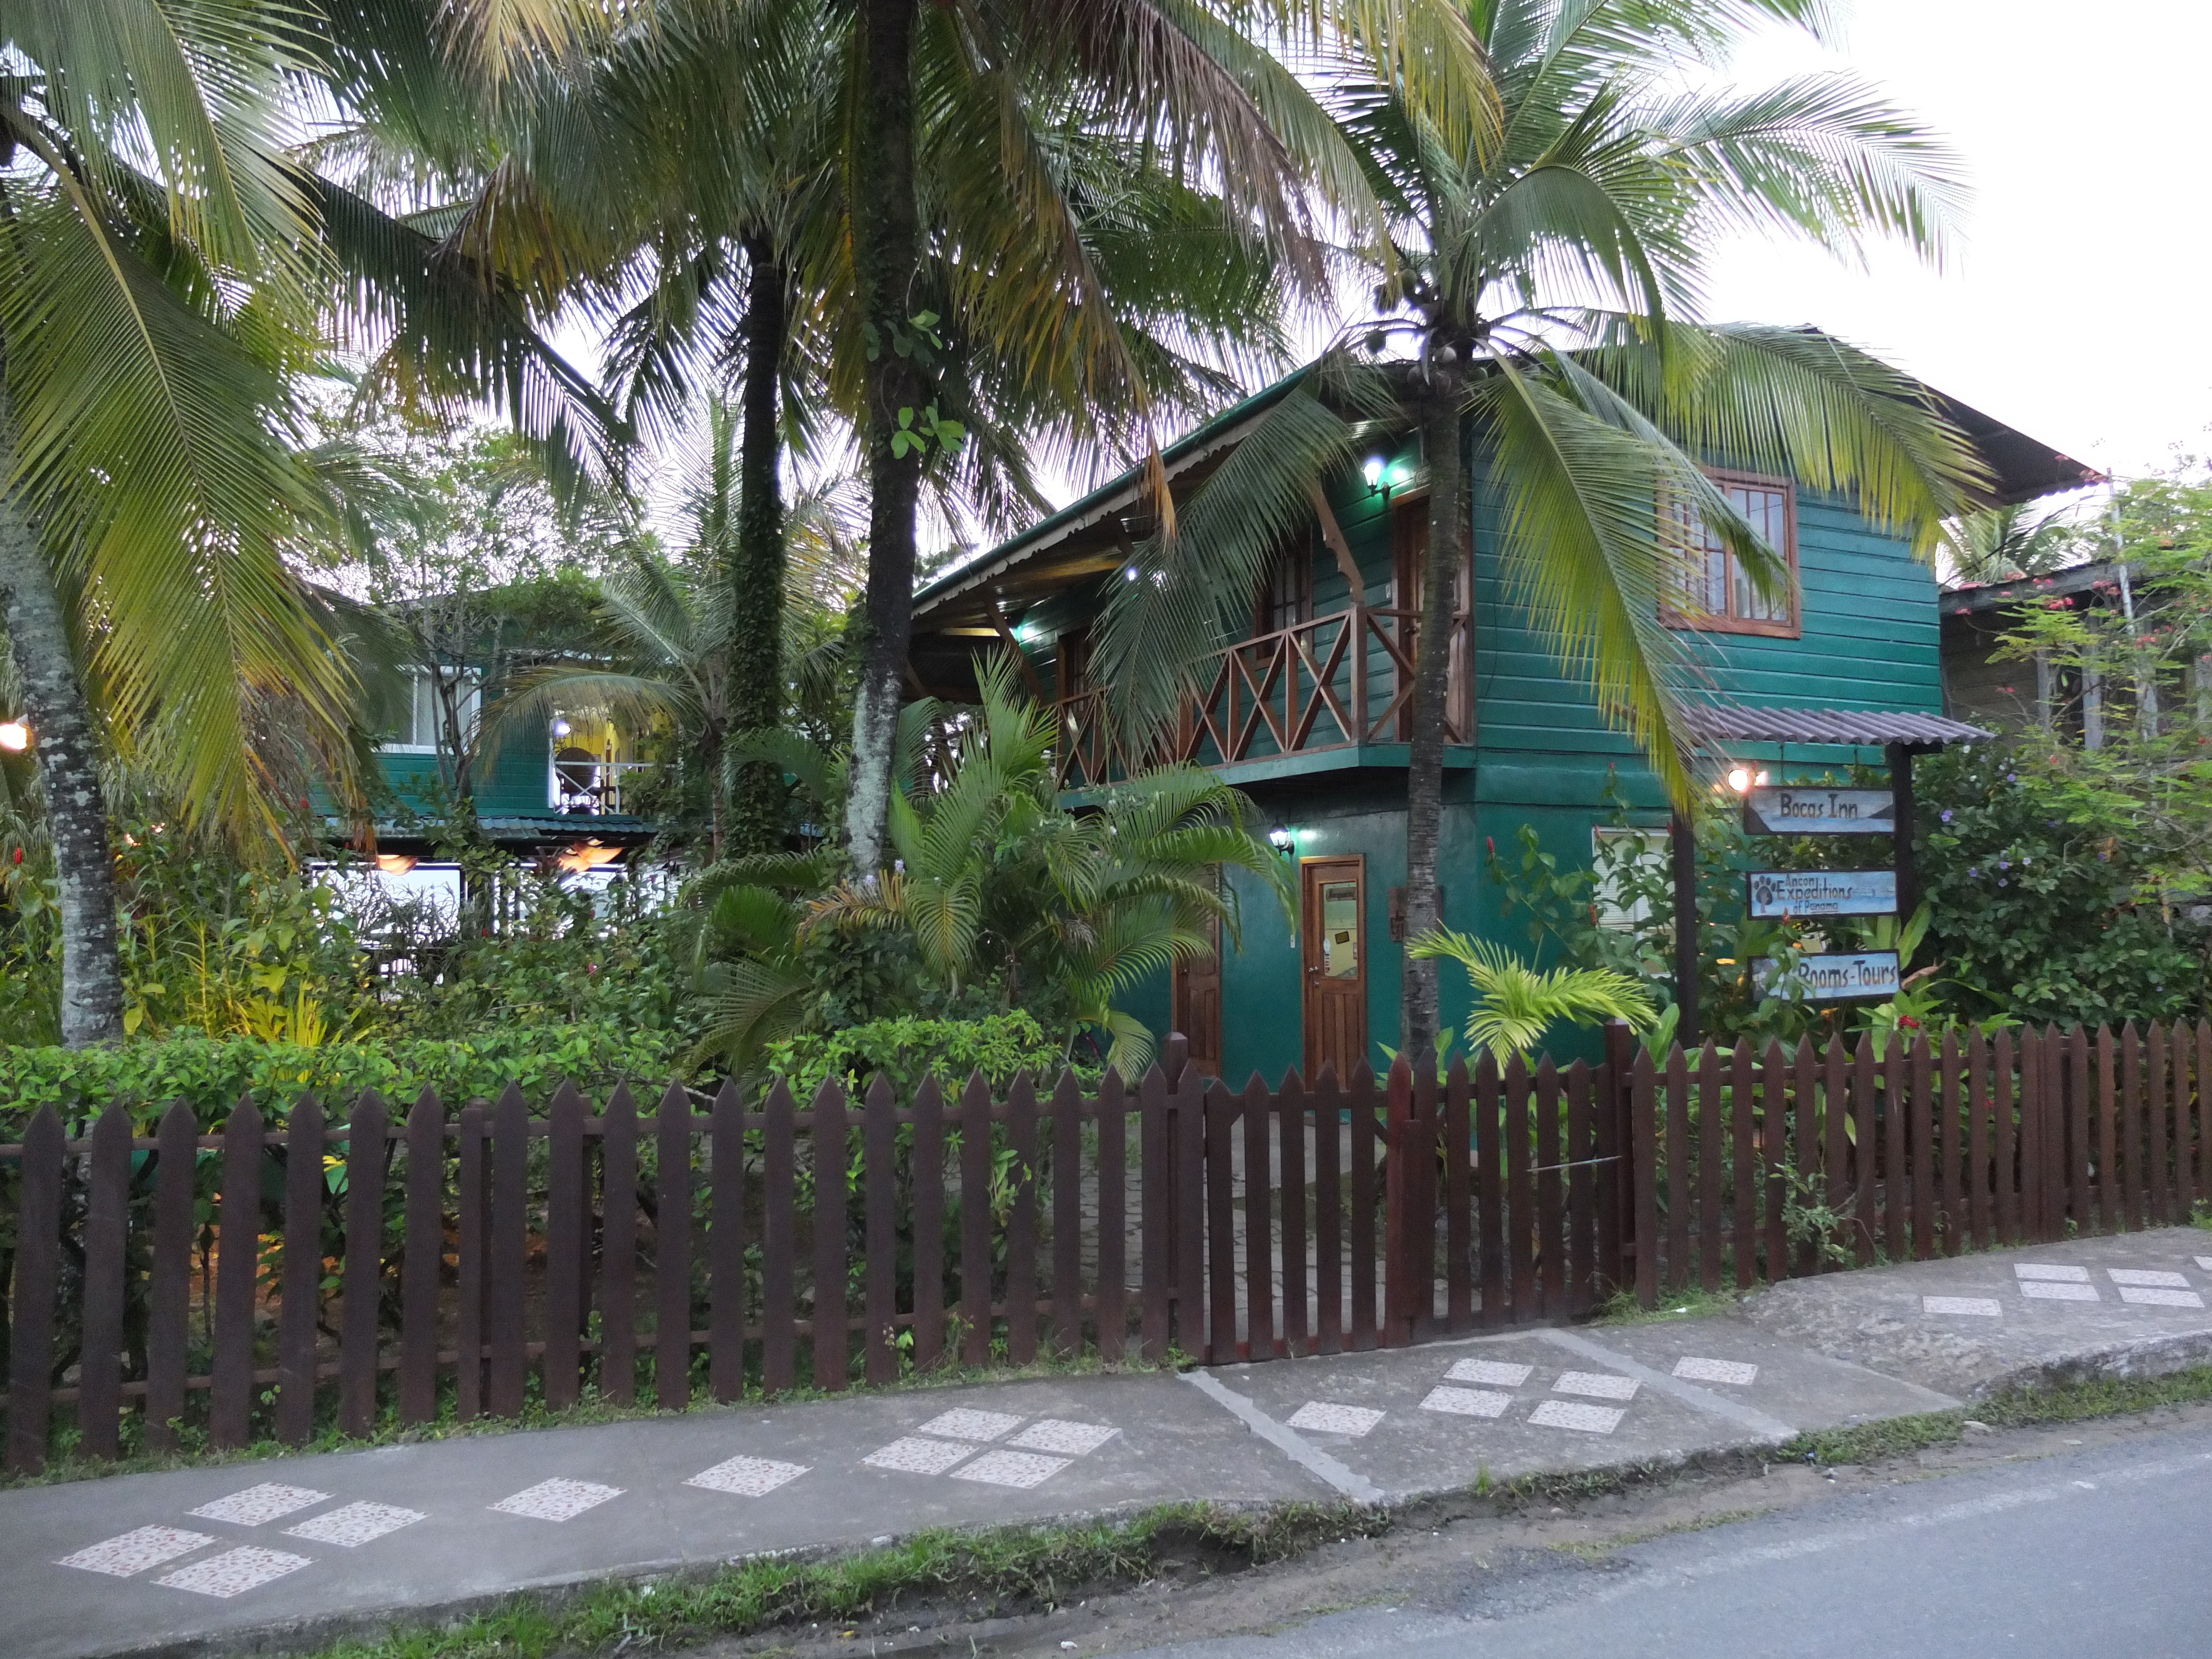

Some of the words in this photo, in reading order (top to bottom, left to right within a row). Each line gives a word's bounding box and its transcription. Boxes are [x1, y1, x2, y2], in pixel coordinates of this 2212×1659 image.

[1780, 792, 1824, 818] Bocas
[1828, 793, 1858, 819] Inn
[1775, 877, 1853, 901] Expeditions
[1786, 874, 1815, 886] Ancon
[1793, 900, 1803, 914] of
[1804, 900, 1839, 912] Panama
